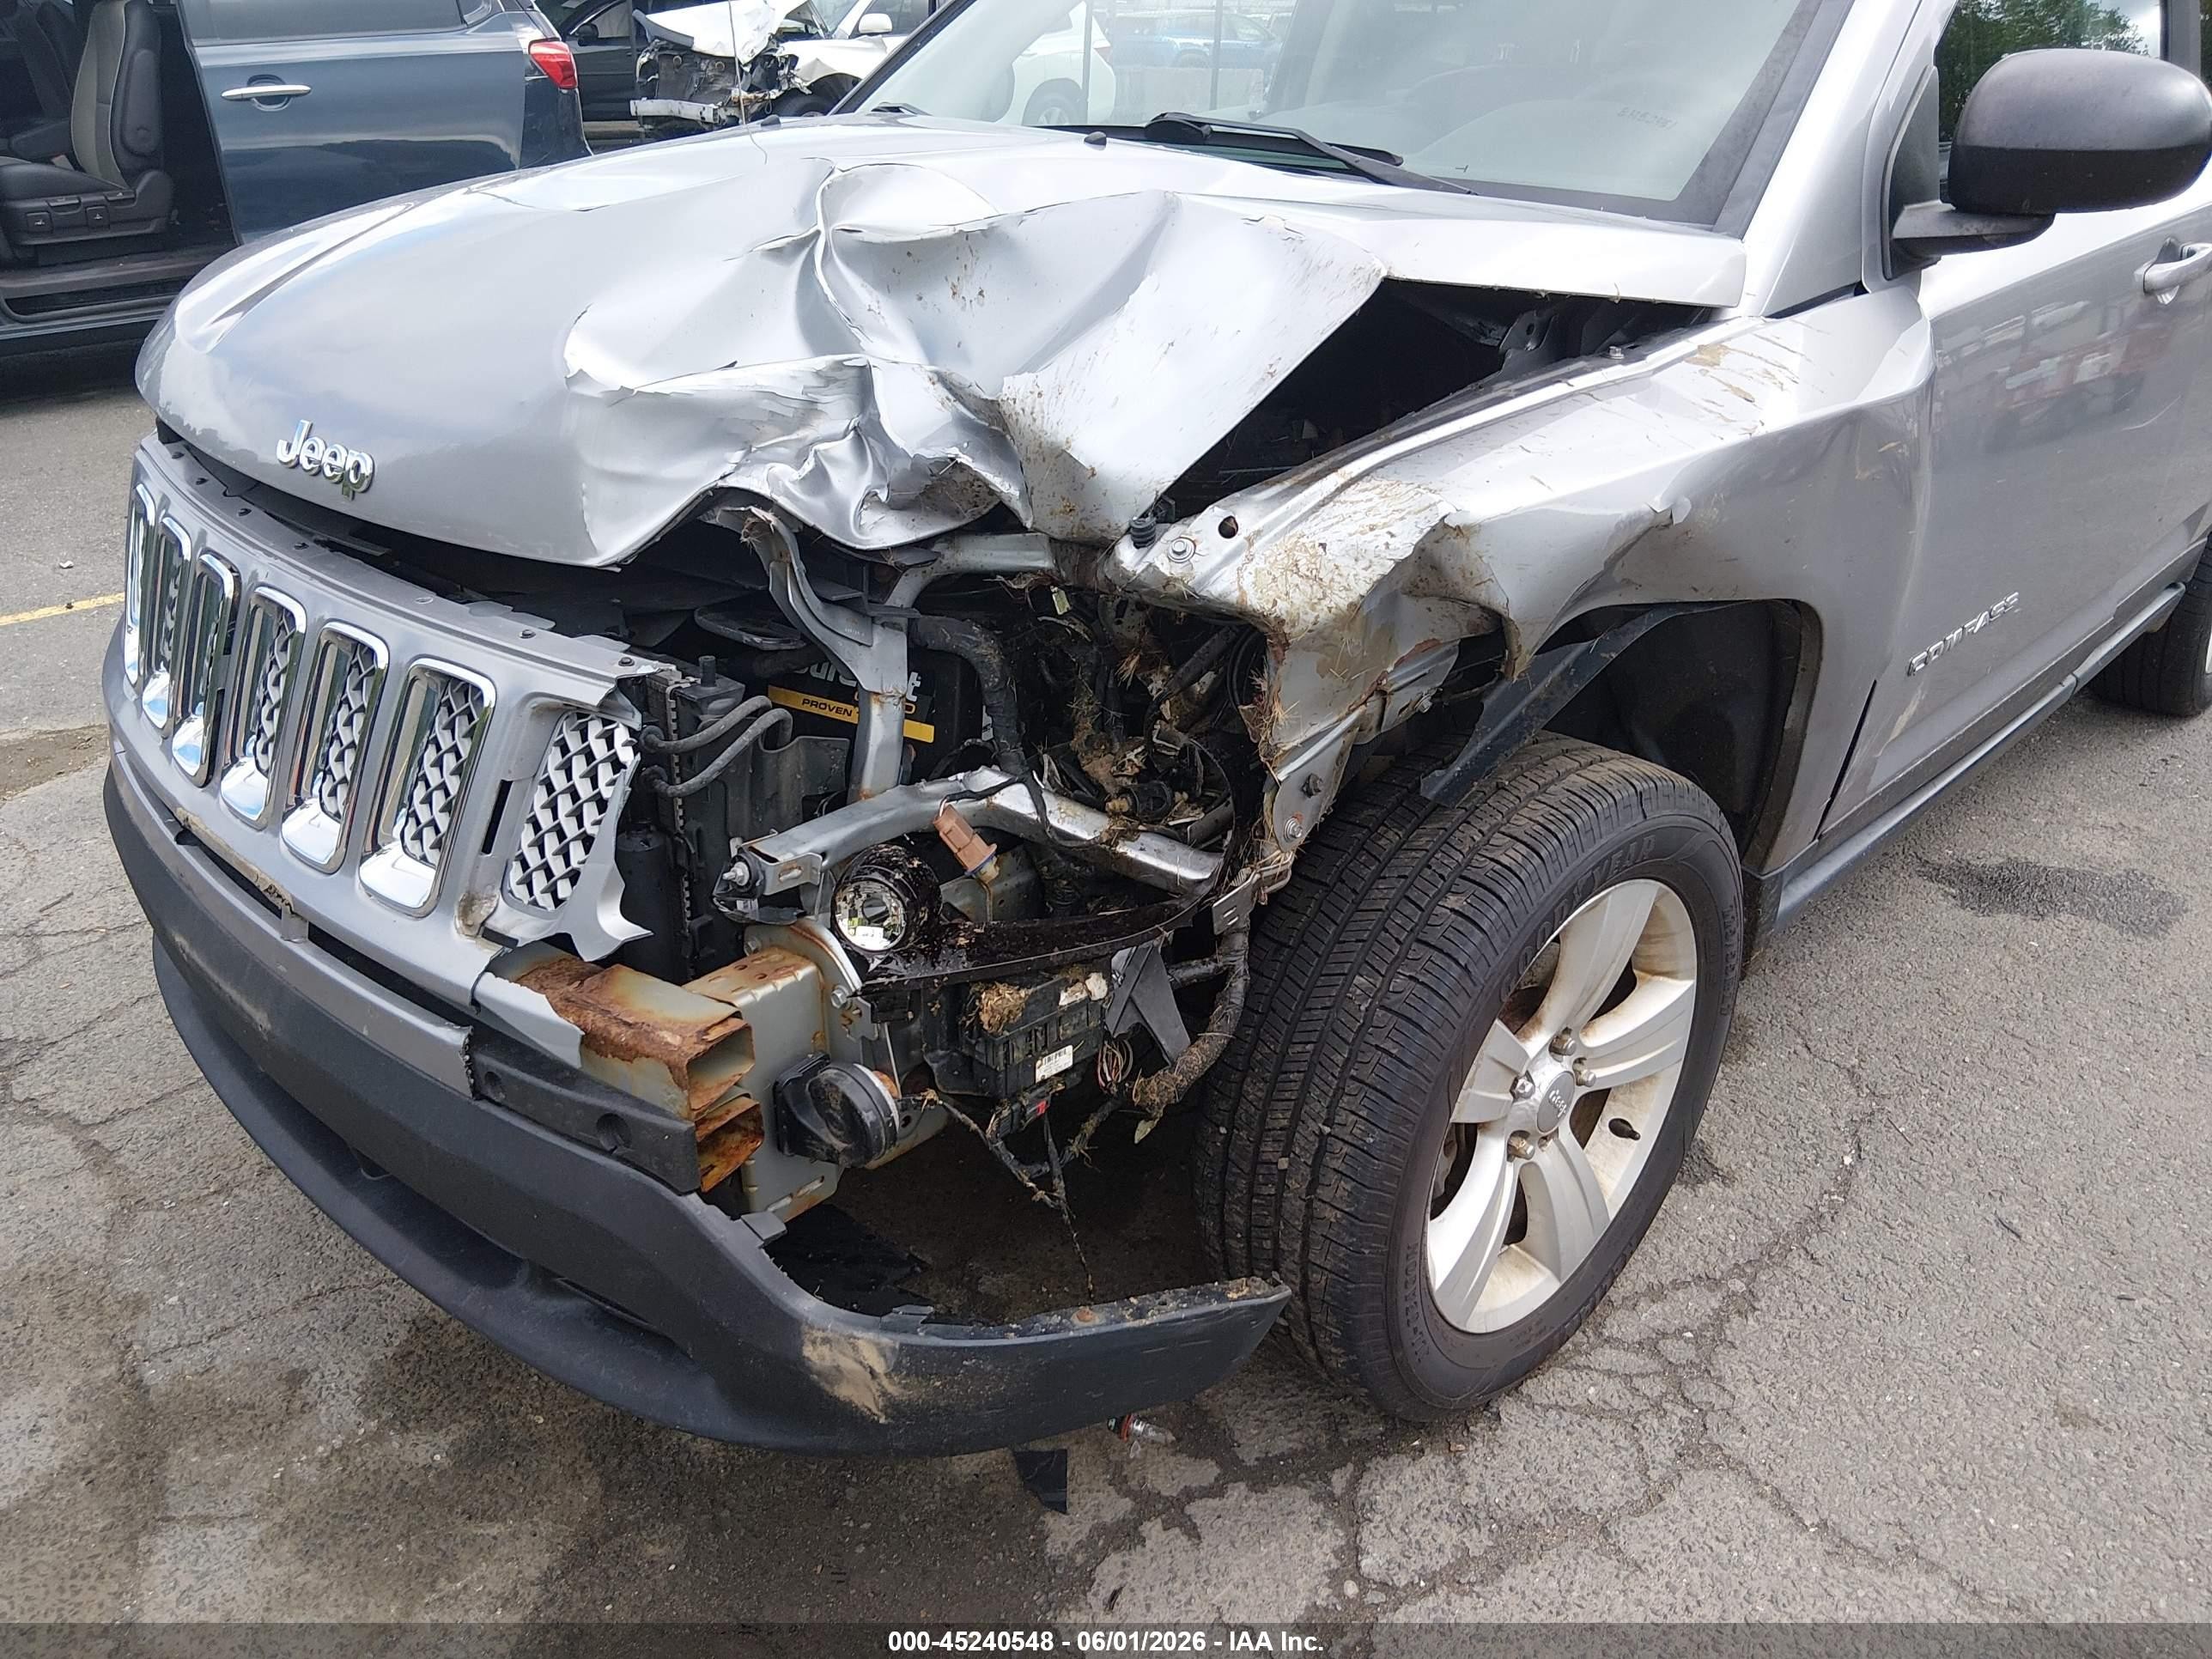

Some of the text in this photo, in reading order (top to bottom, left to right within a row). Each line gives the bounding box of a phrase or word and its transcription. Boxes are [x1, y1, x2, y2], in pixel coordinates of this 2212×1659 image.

[276, 419, 375, 501] Jeep
[1906, 592, 2019, 677] COMPASS
[801, 697, 853, 717] PROVEN
